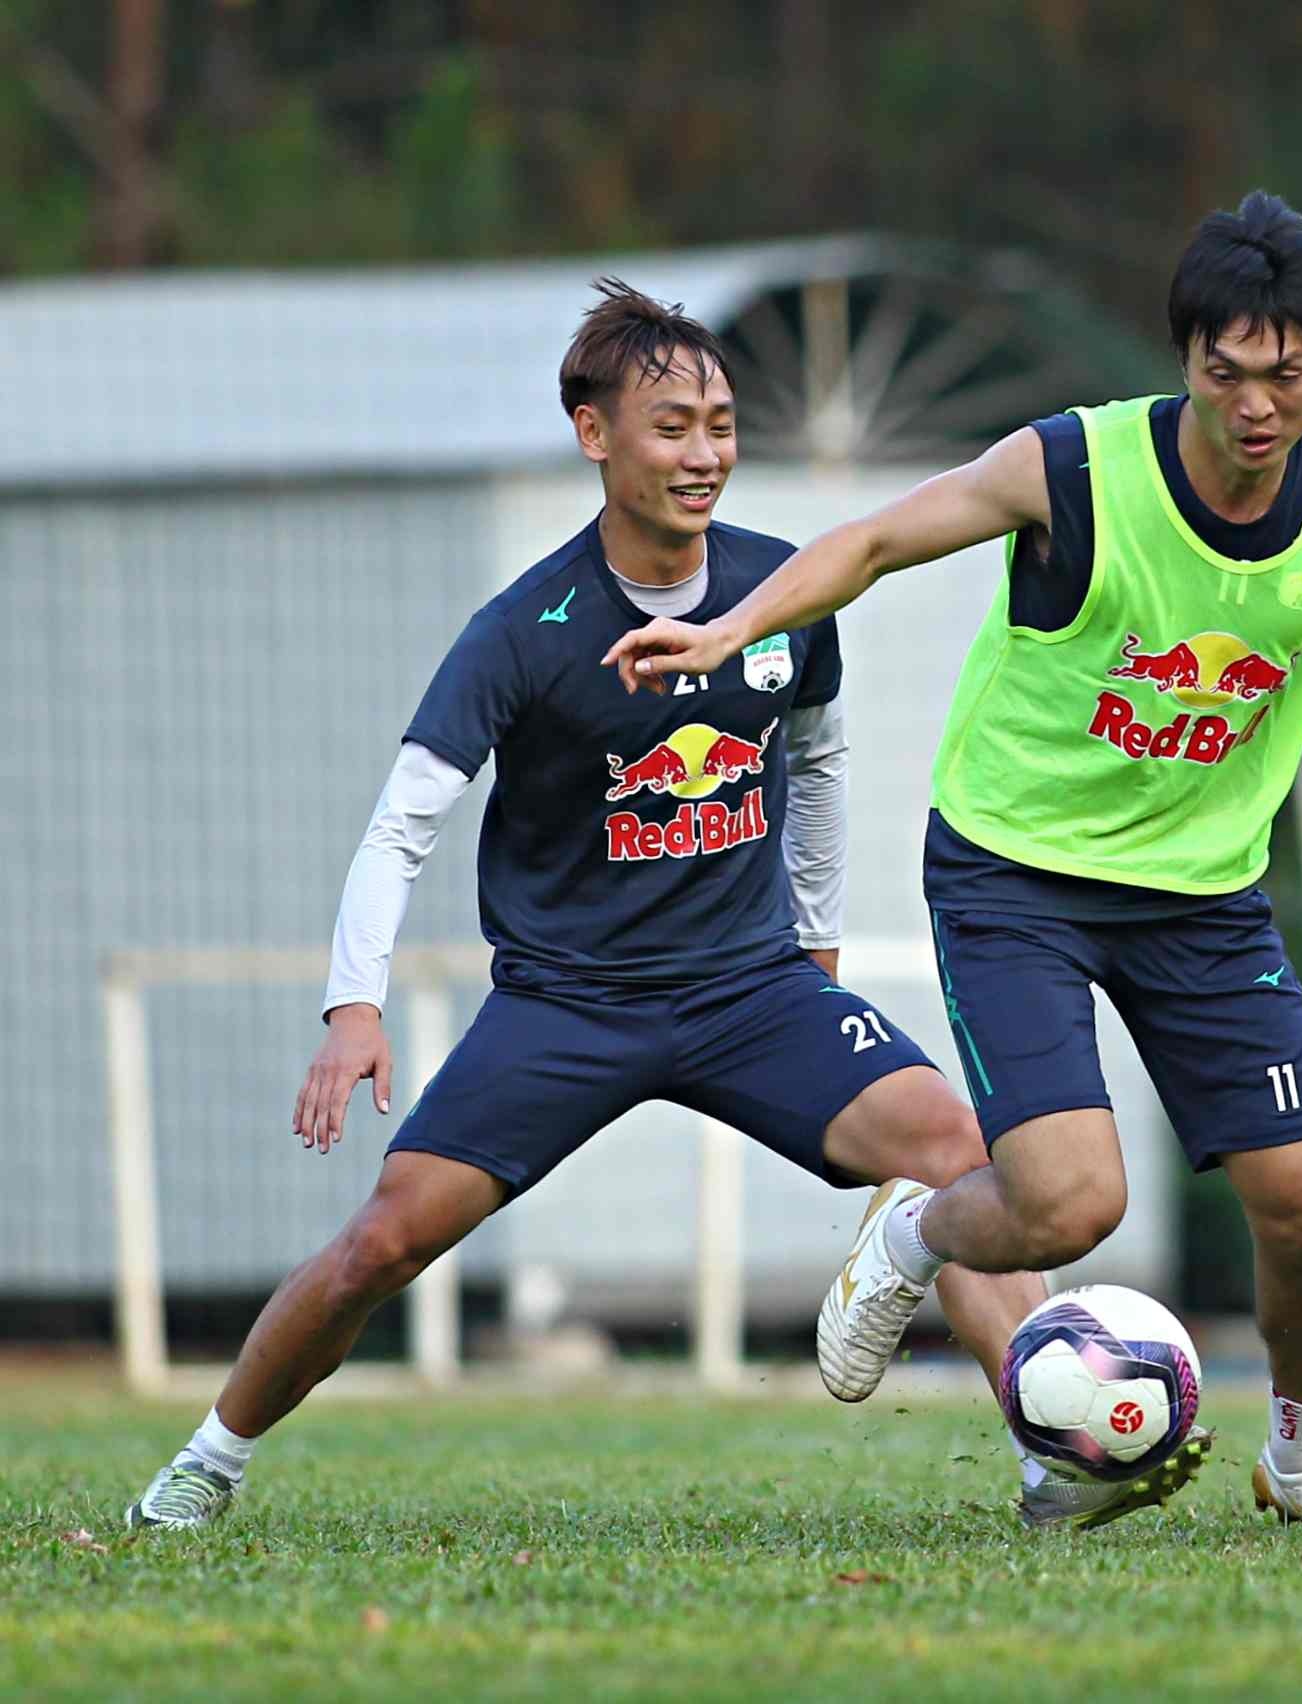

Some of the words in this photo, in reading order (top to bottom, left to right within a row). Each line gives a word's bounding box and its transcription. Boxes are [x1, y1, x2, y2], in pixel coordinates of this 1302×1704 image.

[1088, 691, 1192, 760] Red
[605, 803, 699, 861] Red
[697, 786, 768, 855] Bull
[840, 1010, 892, 1053] 21
[1266, 1063, 1300, 1112] 11
